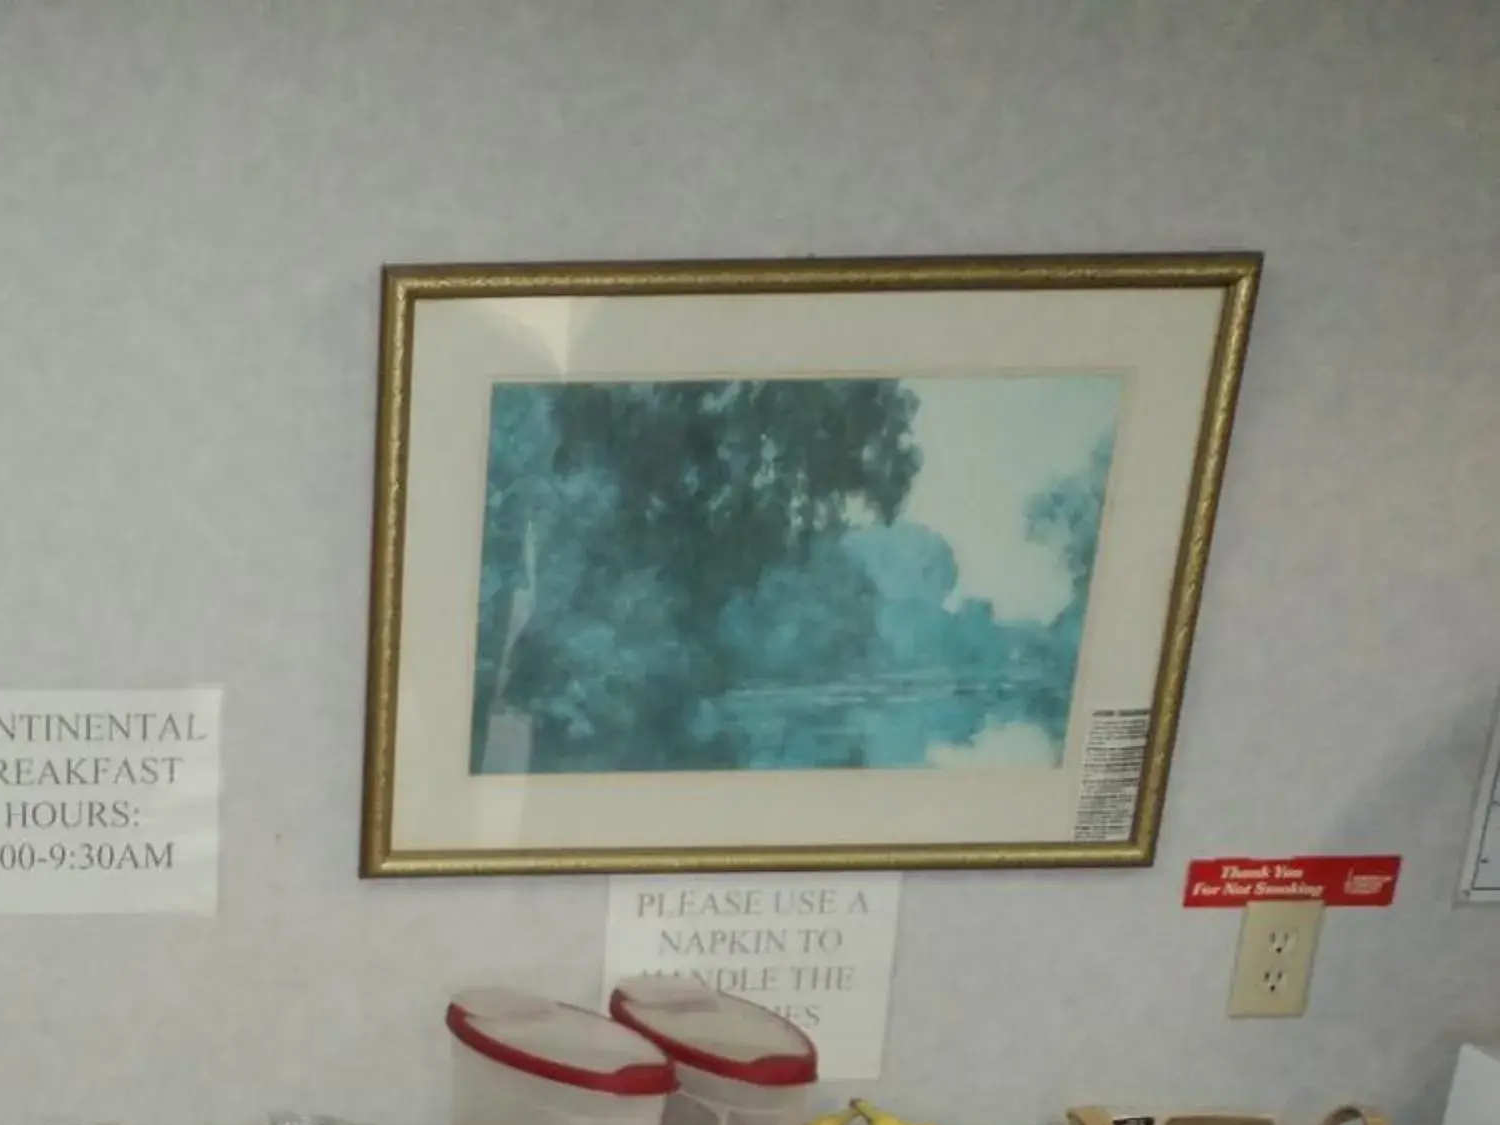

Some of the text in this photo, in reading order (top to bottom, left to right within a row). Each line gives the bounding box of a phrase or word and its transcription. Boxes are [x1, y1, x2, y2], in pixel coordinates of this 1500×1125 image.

[4, 801, 141, 829] HOURS:
[1220, 865, 1304, 879] Thank You
[1192, 881, 1324, 897] For Not Smoking
[637, 889, 870, 918] PLEASE USE A
[657, 928, 844, 956] NAPKIN TO
[790, 966, 854, 991] THE
